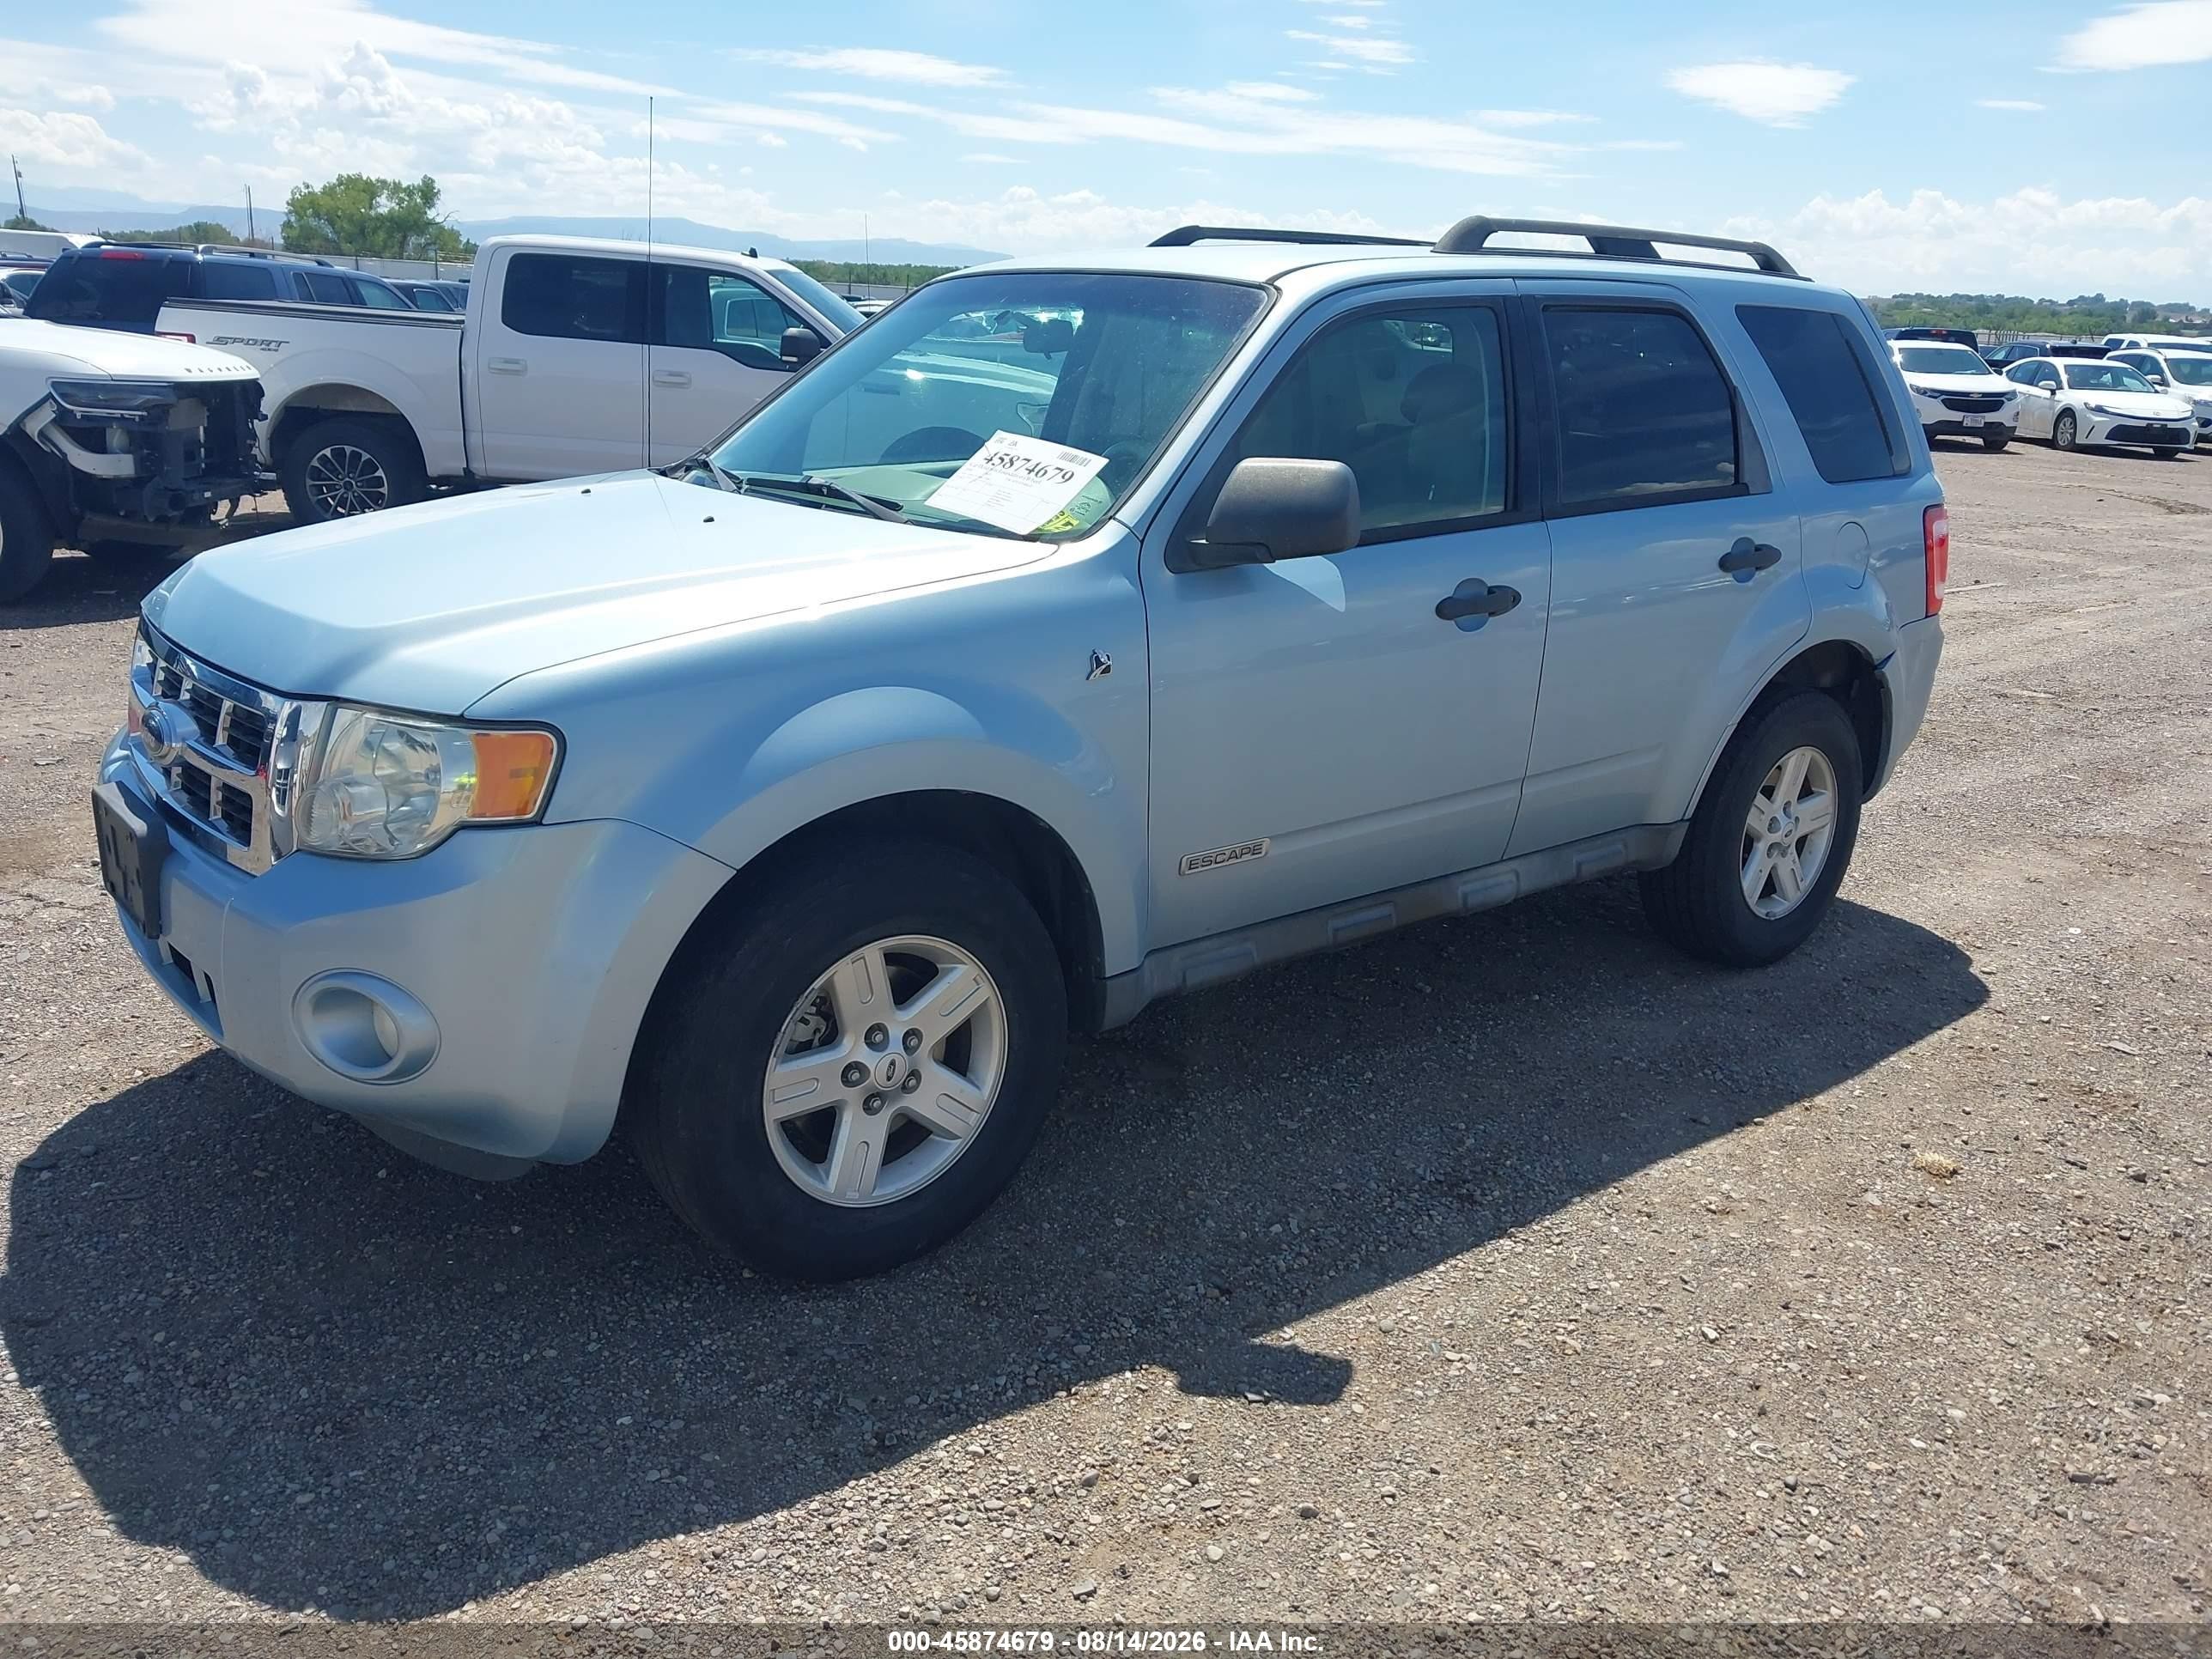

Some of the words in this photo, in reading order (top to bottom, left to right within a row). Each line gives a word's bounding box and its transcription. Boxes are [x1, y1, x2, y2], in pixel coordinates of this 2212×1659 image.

[206, 336, 290, 348] SPORT
[983, 452, 1074, 484] 45874679
[1188, 844, 1263, 870] ESCAPE
